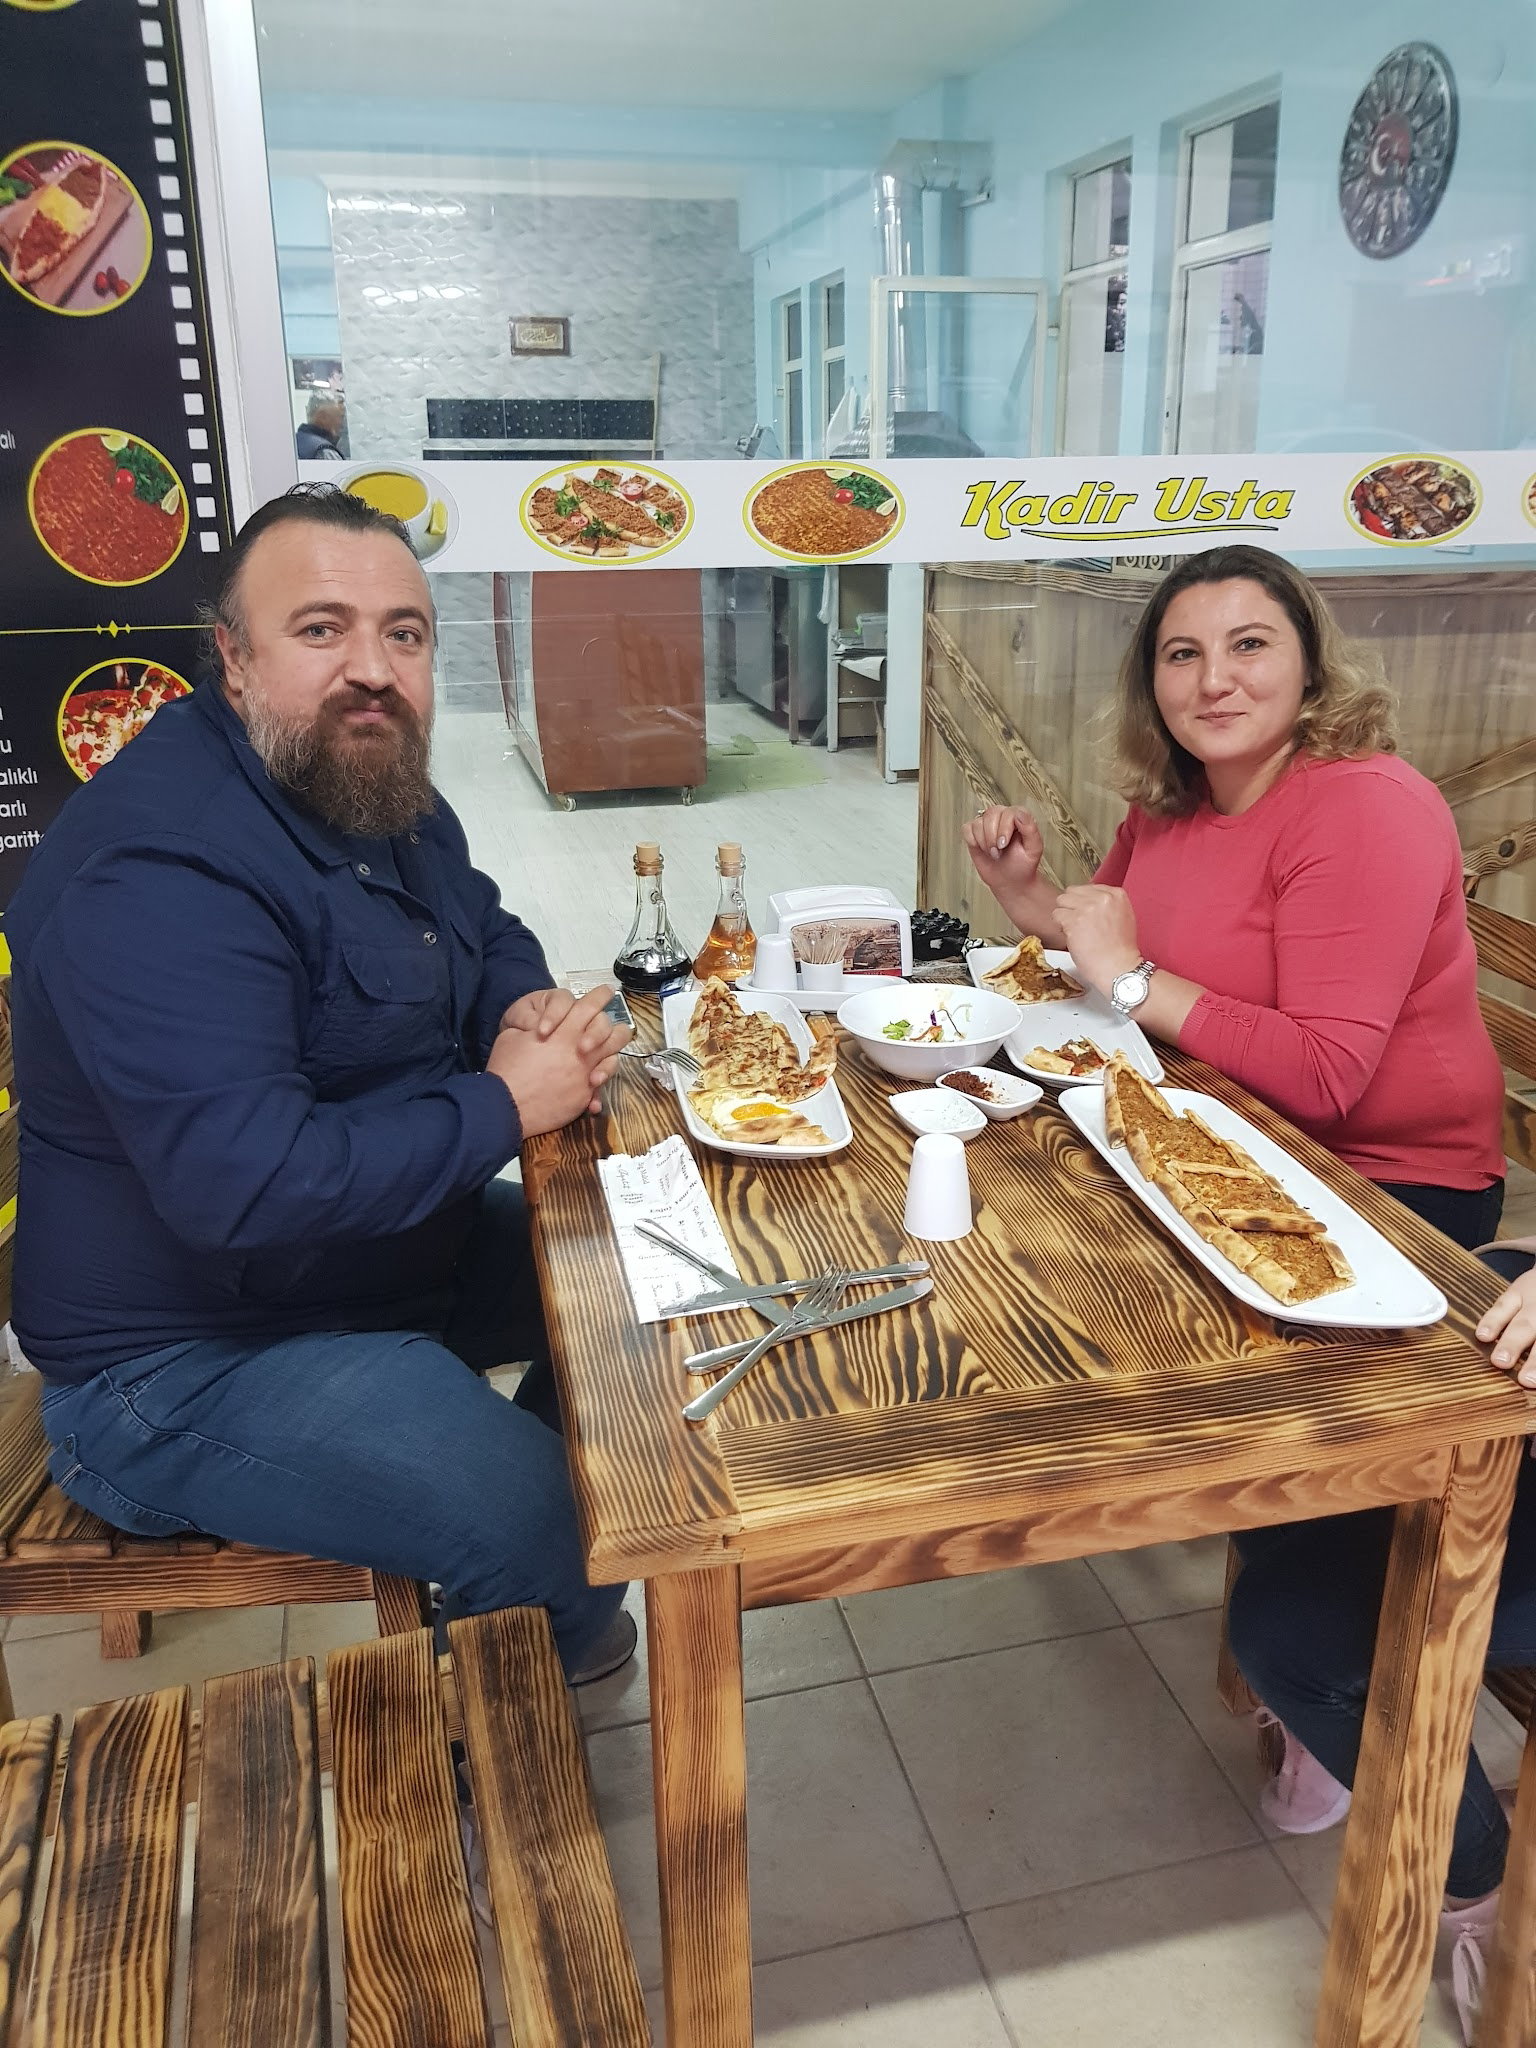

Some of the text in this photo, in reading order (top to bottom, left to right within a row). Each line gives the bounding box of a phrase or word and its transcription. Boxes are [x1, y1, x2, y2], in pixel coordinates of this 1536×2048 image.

[960, 476, 1296, 541] Kadir Usta
[0, 830, 45, 854] aritt
